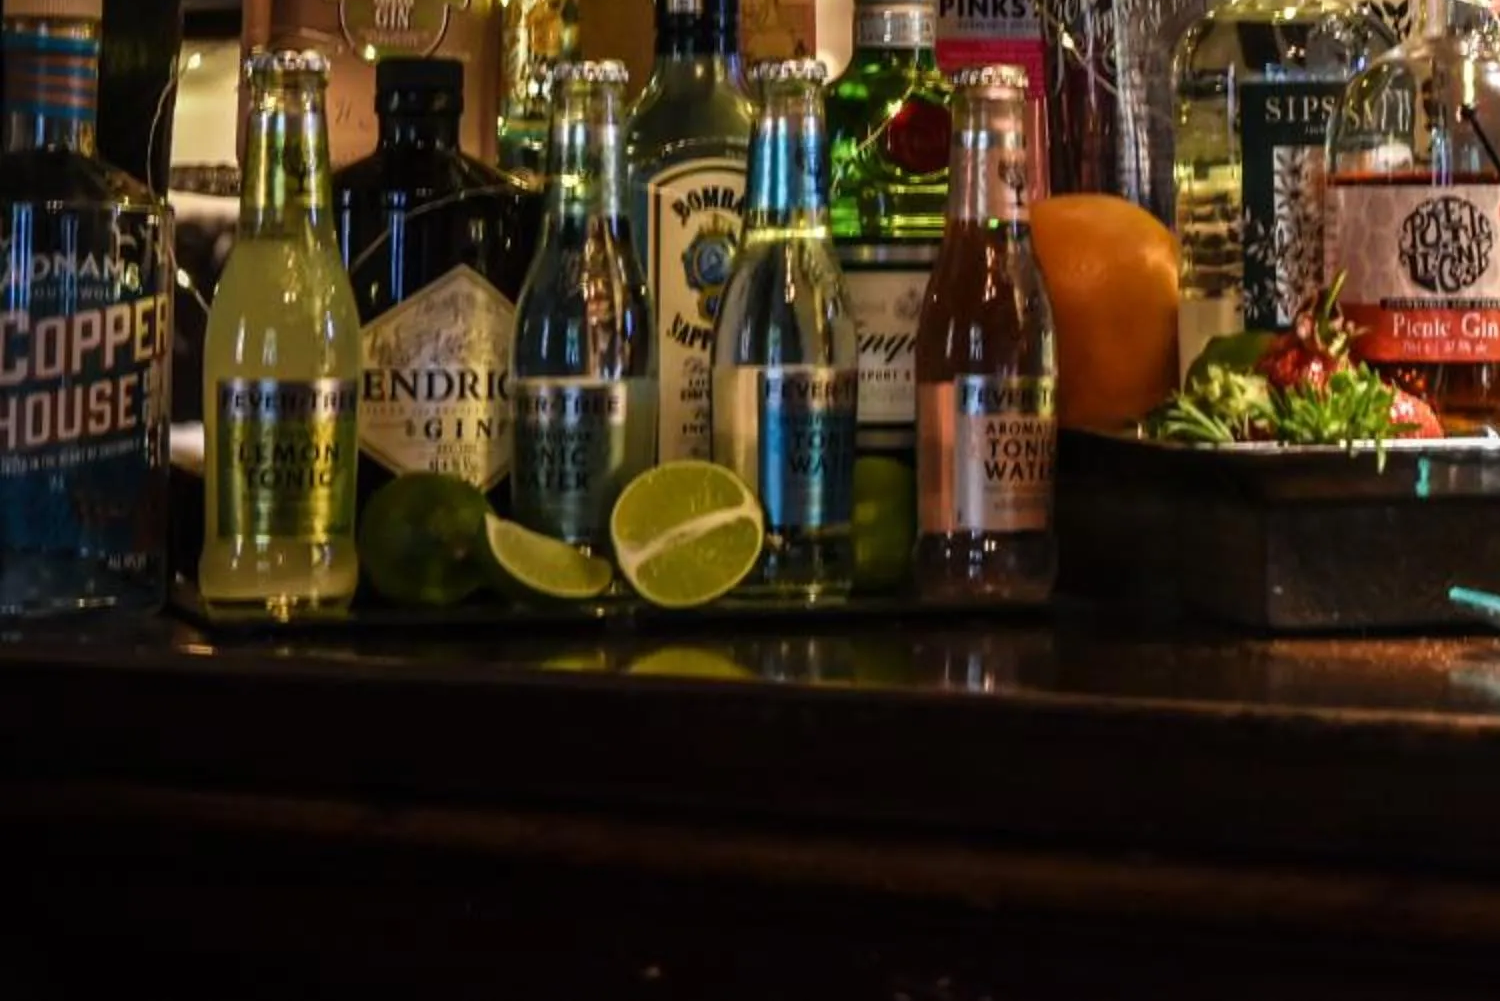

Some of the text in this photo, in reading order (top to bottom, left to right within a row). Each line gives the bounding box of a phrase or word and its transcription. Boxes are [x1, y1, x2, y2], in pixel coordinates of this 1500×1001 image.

[374, 8, 413, 31] GIN
[1392, 311, 1500, 341] Picnic Gin
[0, 293, 171, 386] COPPER
[423, 417, 494, 440] GIN
[239, 441, 341, 464] LEMON
